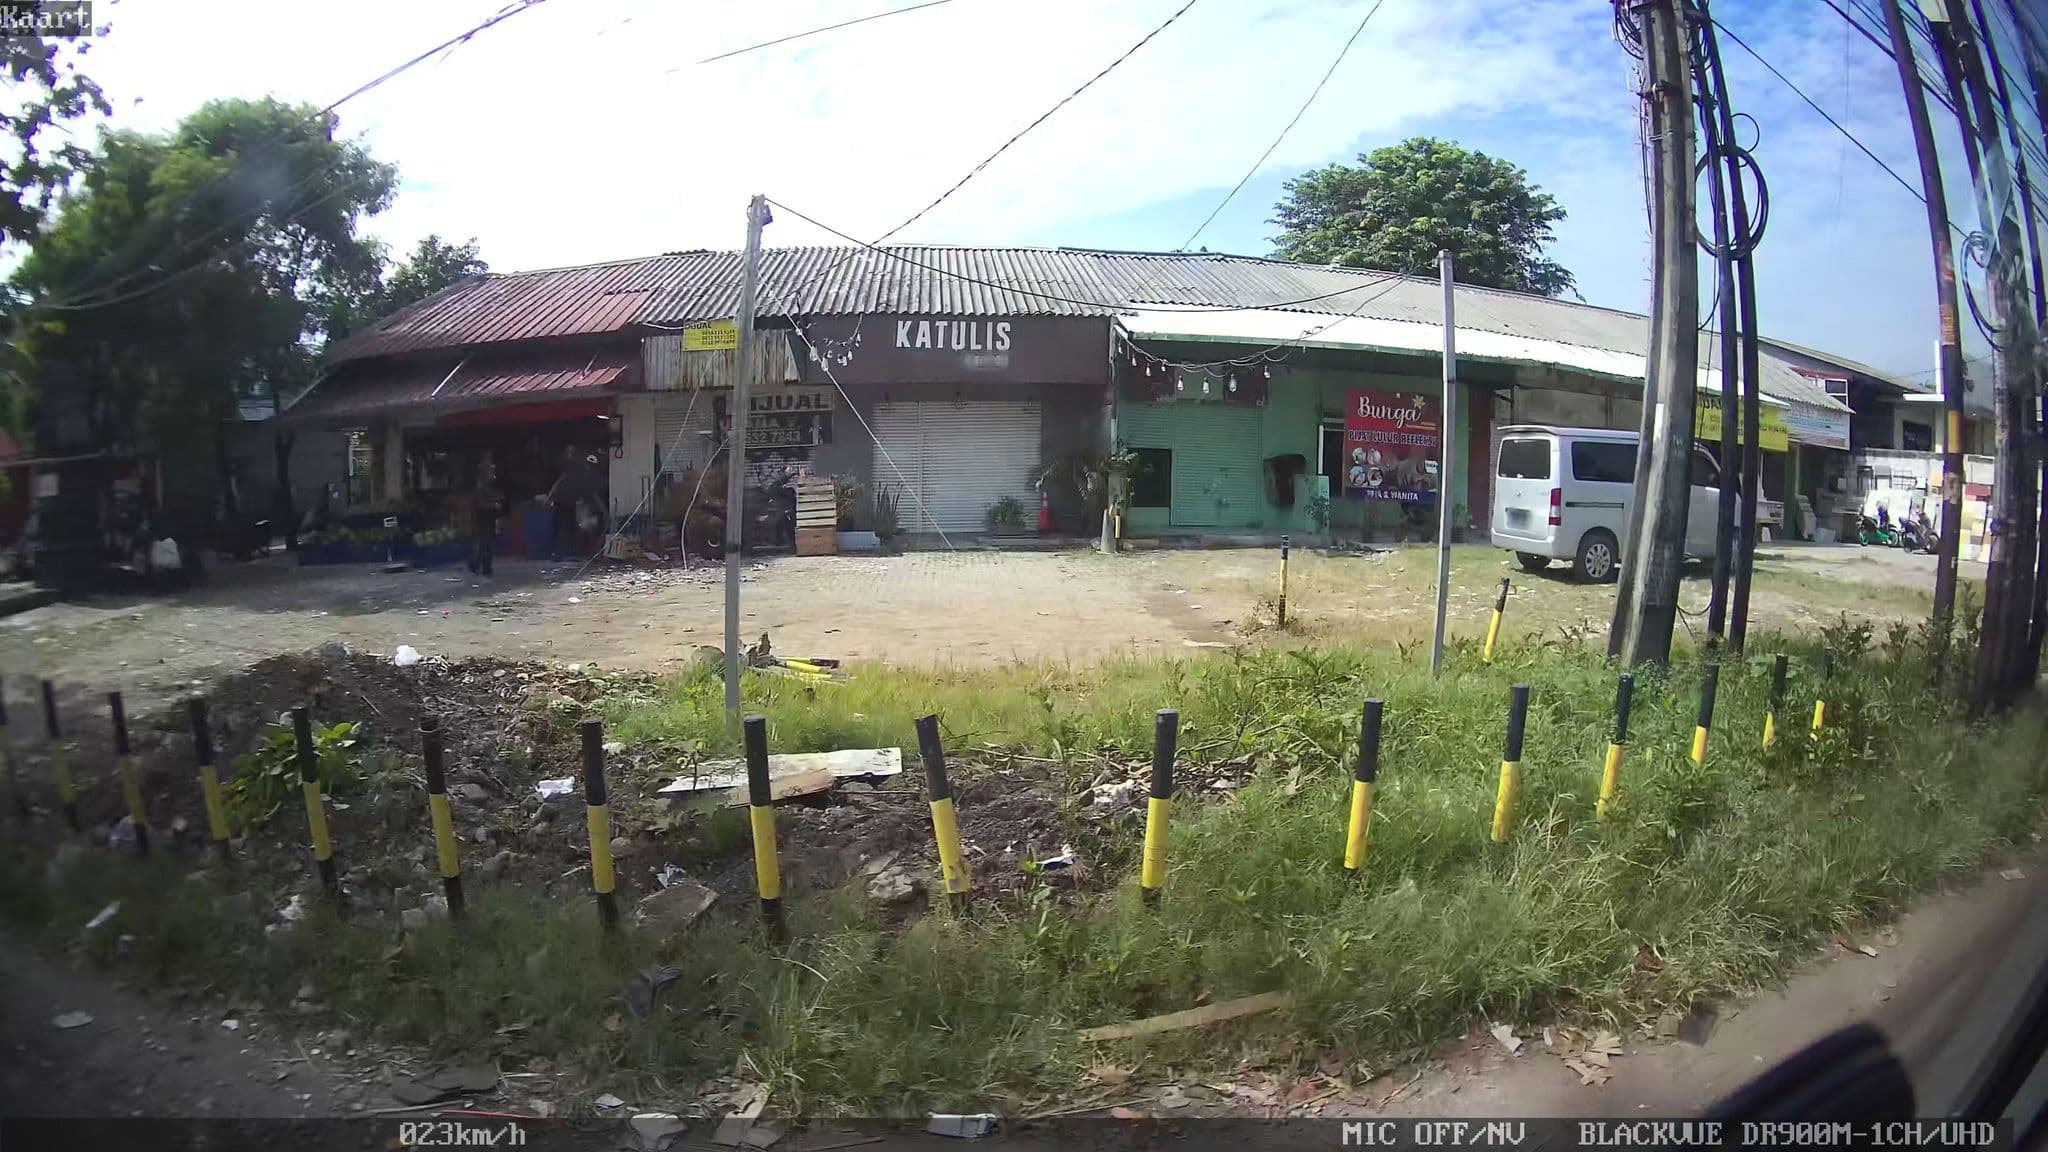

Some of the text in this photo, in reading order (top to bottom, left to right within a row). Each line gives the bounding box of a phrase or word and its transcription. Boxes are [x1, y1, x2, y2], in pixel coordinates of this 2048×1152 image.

[895, 320, 1011, 351] KATULIS
[1357, 396, 1421, 428] Bunga
[1390, 491, 1419, 501] WANITA
